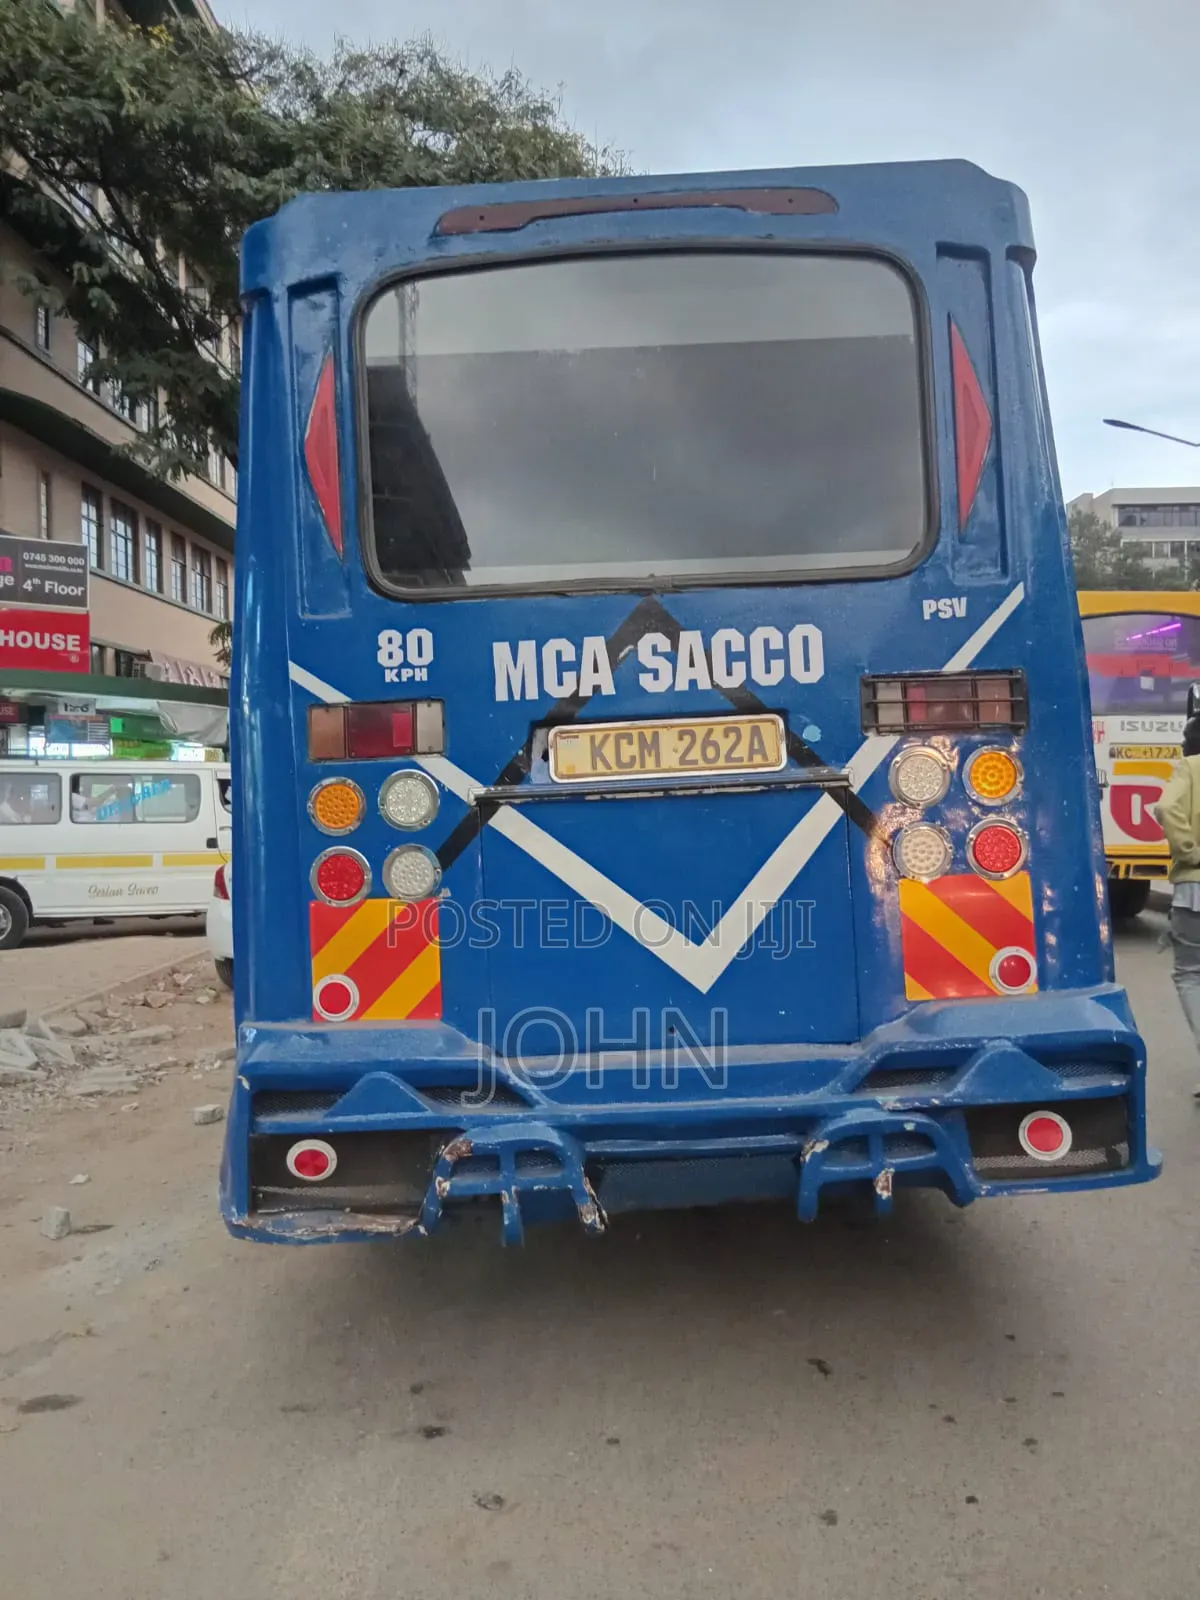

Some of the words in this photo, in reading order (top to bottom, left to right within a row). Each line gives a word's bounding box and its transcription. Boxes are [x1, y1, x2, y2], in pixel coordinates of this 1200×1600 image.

[22, 577, 42, 592] 4th
[44, 580, 85, 596] Floor
[922, 597, 967, 620] PSV
[0, 629, 81, 652] HOUSE
[377, 628, 434, 667] 80
[493, 635, 616, 701] MCA
[637, 624, 825, 693] SACCO
[384, 667, 428, 683] KPH
[589, 730, 662, 771] KCM
[677, 724, 769, 766] 262A
